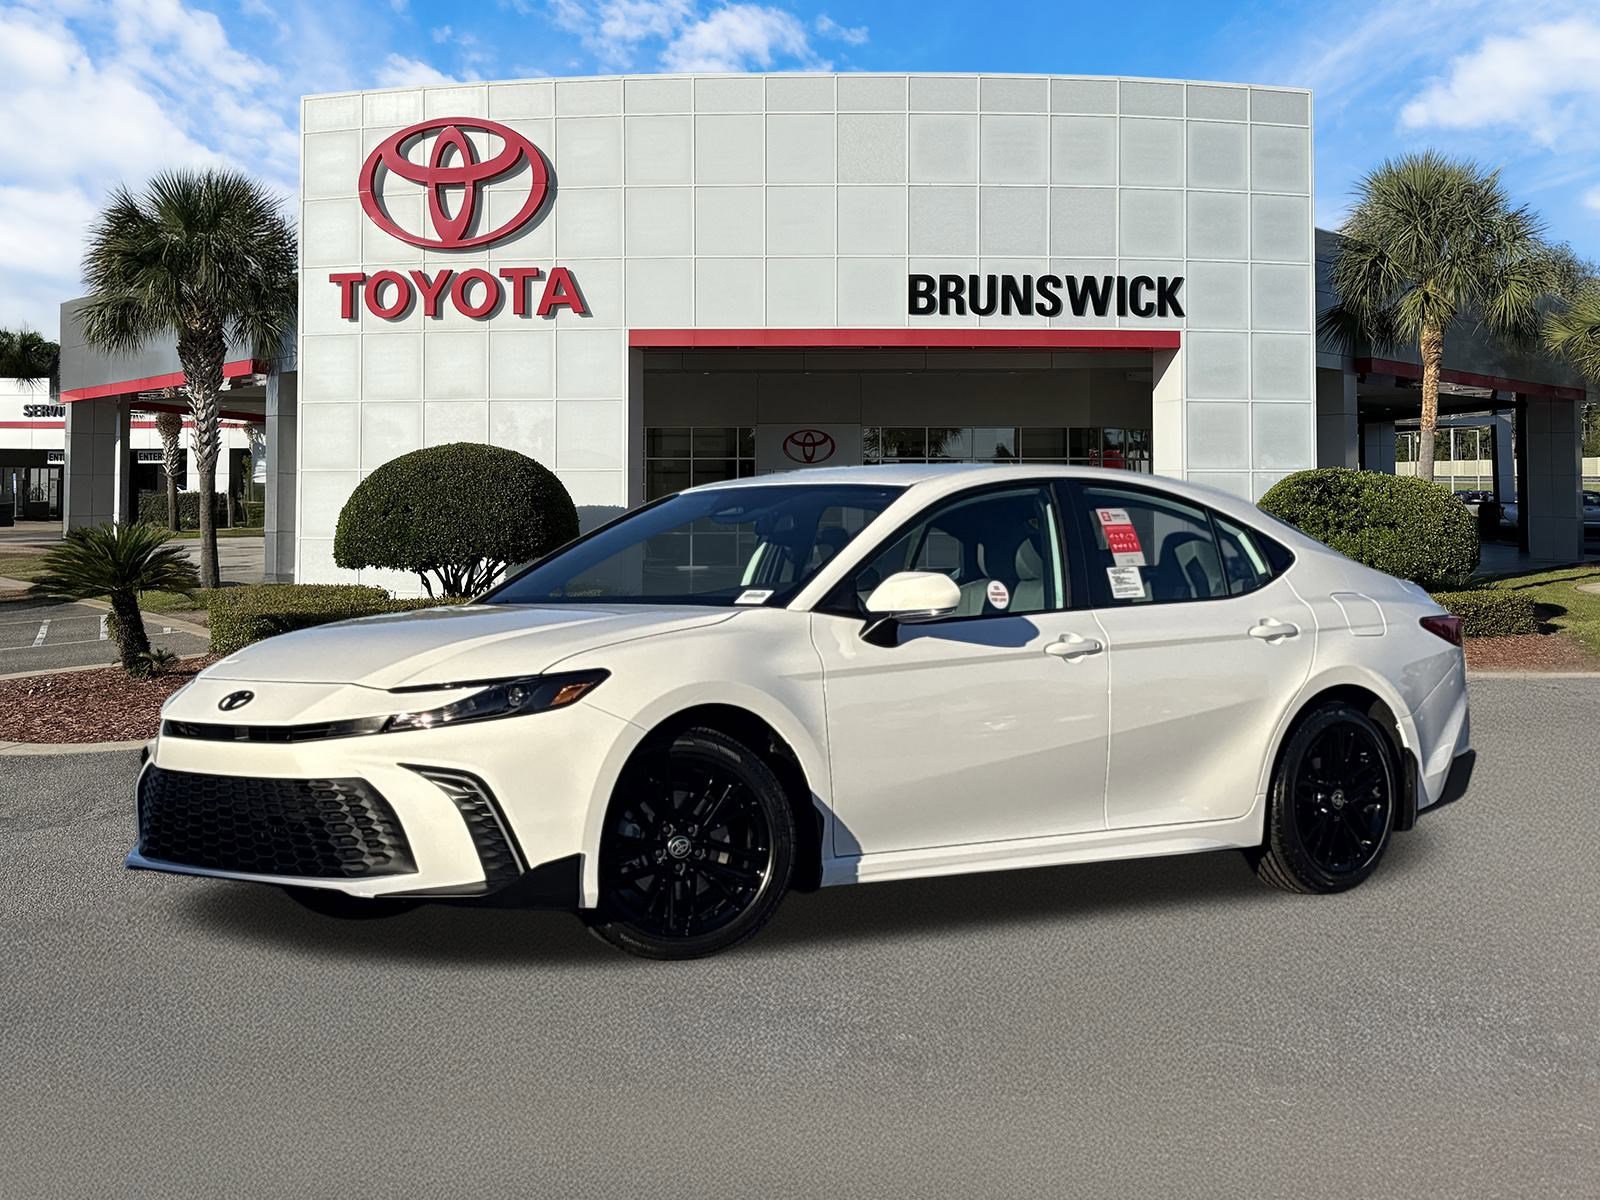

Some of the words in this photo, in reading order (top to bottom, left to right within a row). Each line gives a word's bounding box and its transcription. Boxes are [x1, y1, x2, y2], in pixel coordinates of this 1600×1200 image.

[329, 267, 588, 319] TOYOTA
[908, 274, 1186, 317] BRUNSWICK
[23, 404, 65, 417] SERVI
[139, 452, 163, 461] ENTER
